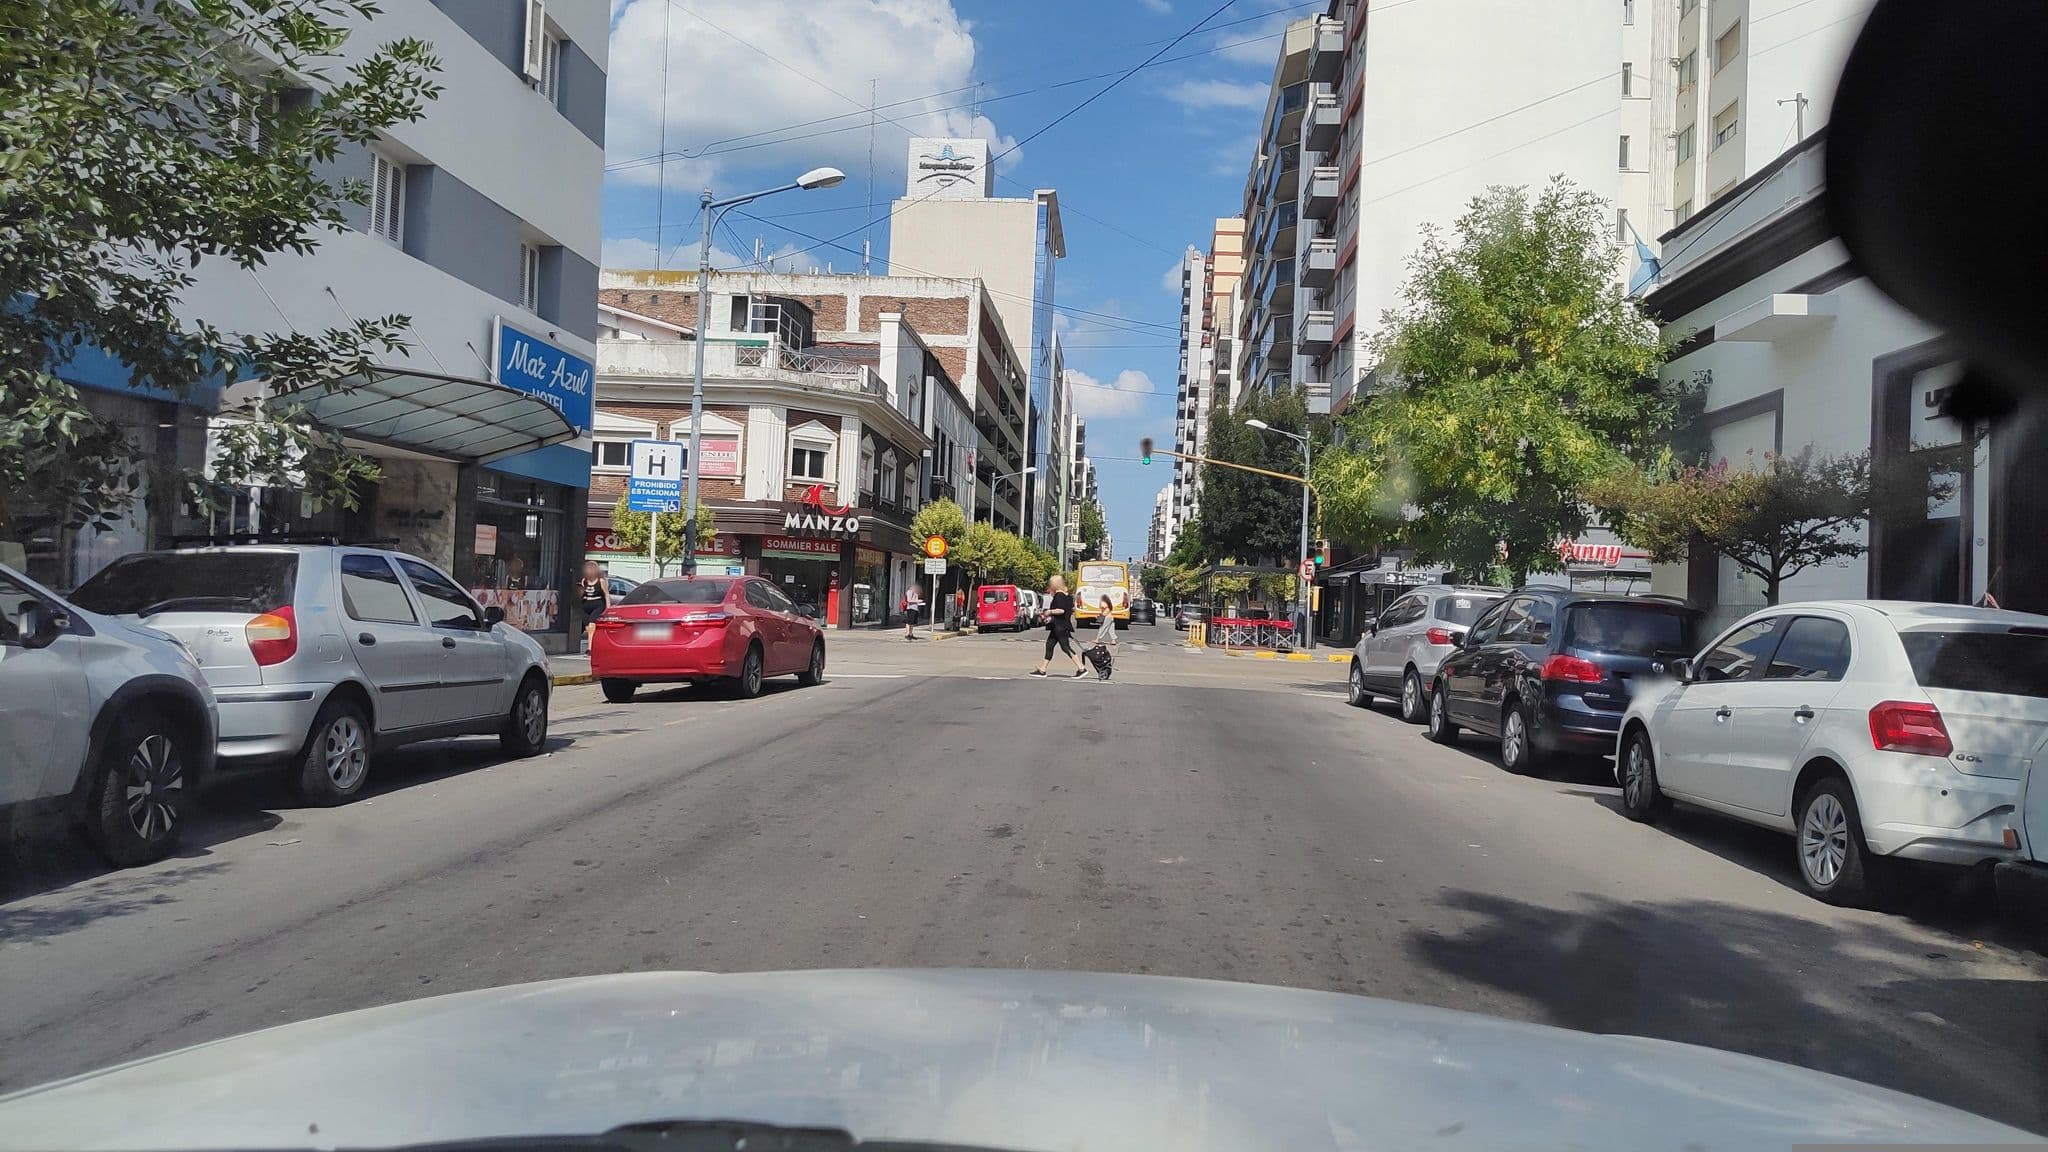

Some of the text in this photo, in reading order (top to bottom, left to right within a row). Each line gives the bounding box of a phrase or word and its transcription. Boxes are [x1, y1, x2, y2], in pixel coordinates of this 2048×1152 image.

[507, 340, 589, 396] Mar Azul
[634, 480, 677, 489] PROHIBIDO
[631, 488, 680, 497] ESTACIONAR
[784, 512, 859, 533] MANZO
[767, 539, 837, 552] SOMMIER SALE
[1956, 753, 1983, 763] GOL
